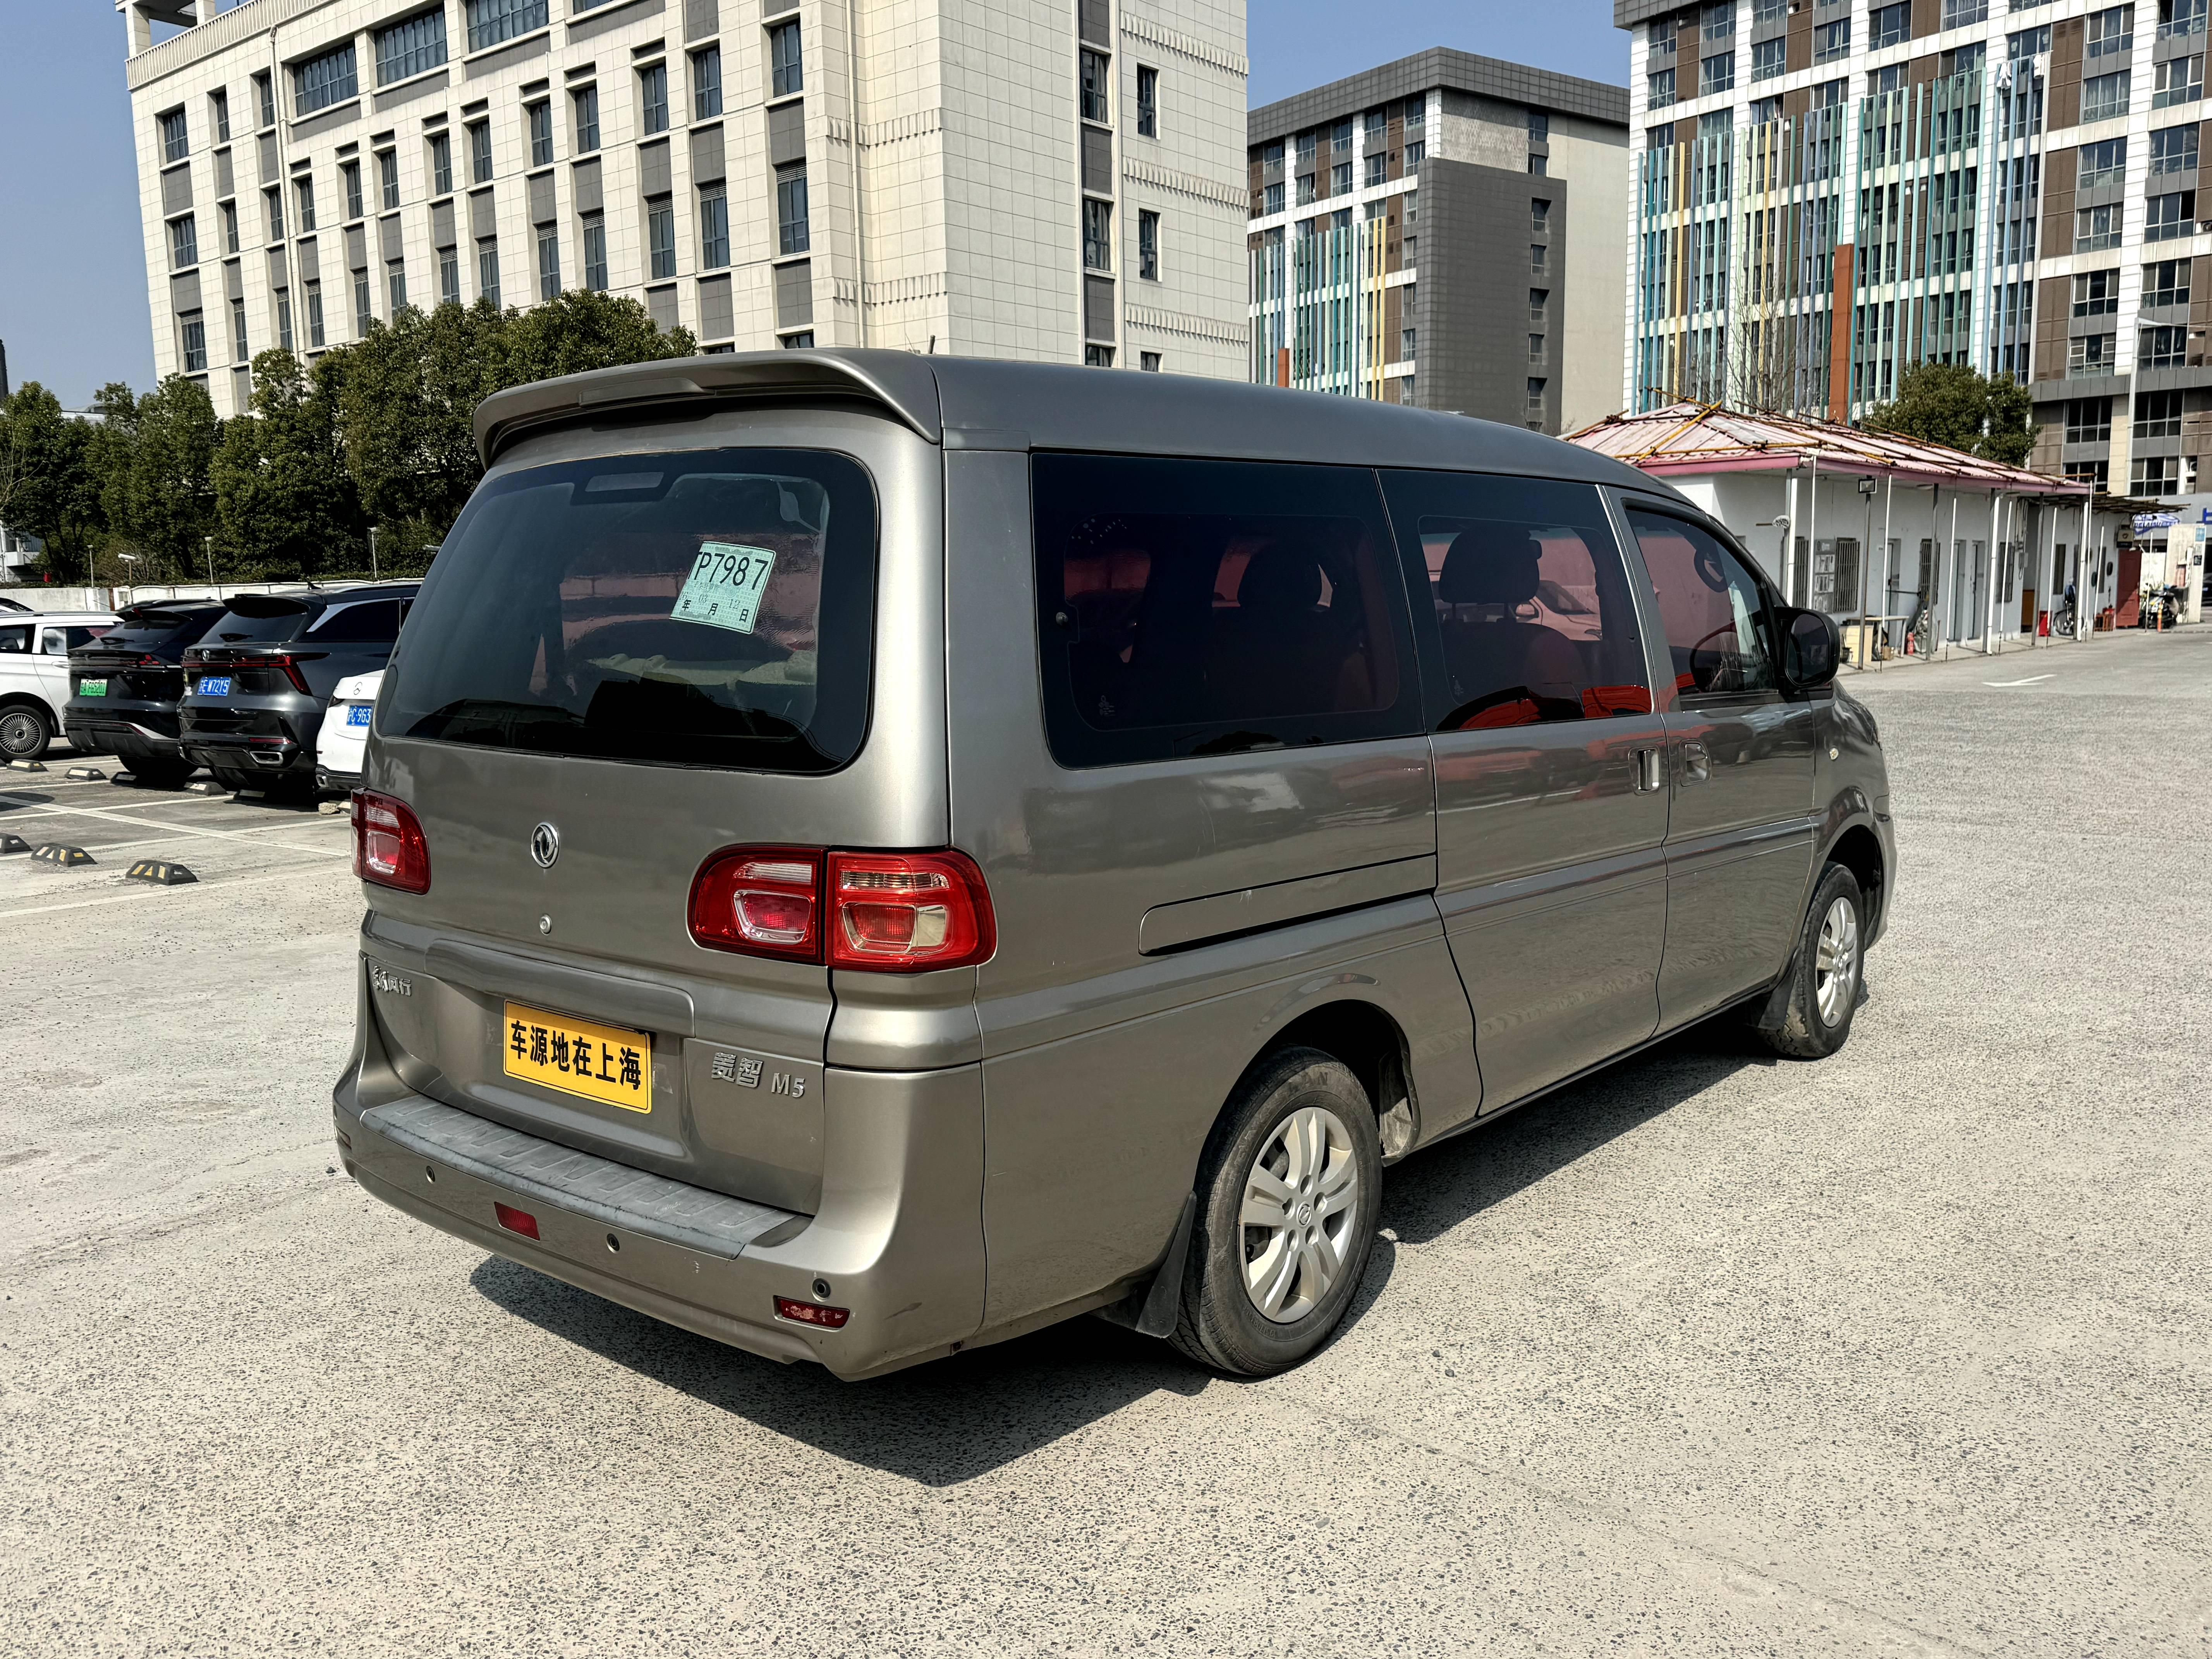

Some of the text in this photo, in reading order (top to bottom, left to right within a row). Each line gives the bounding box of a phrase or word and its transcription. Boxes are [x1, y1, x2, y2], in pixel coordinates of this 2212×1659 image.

[682, 599, 691, 611] 年
[708, 603, 718, 615] 月
[729, 599, 740, 609] 12
[739, 609, 749, 623] 日
[510, 1019, 642, 1091] 车源地在上海
[711, 1051, 806, 1098] 菱智 M5
